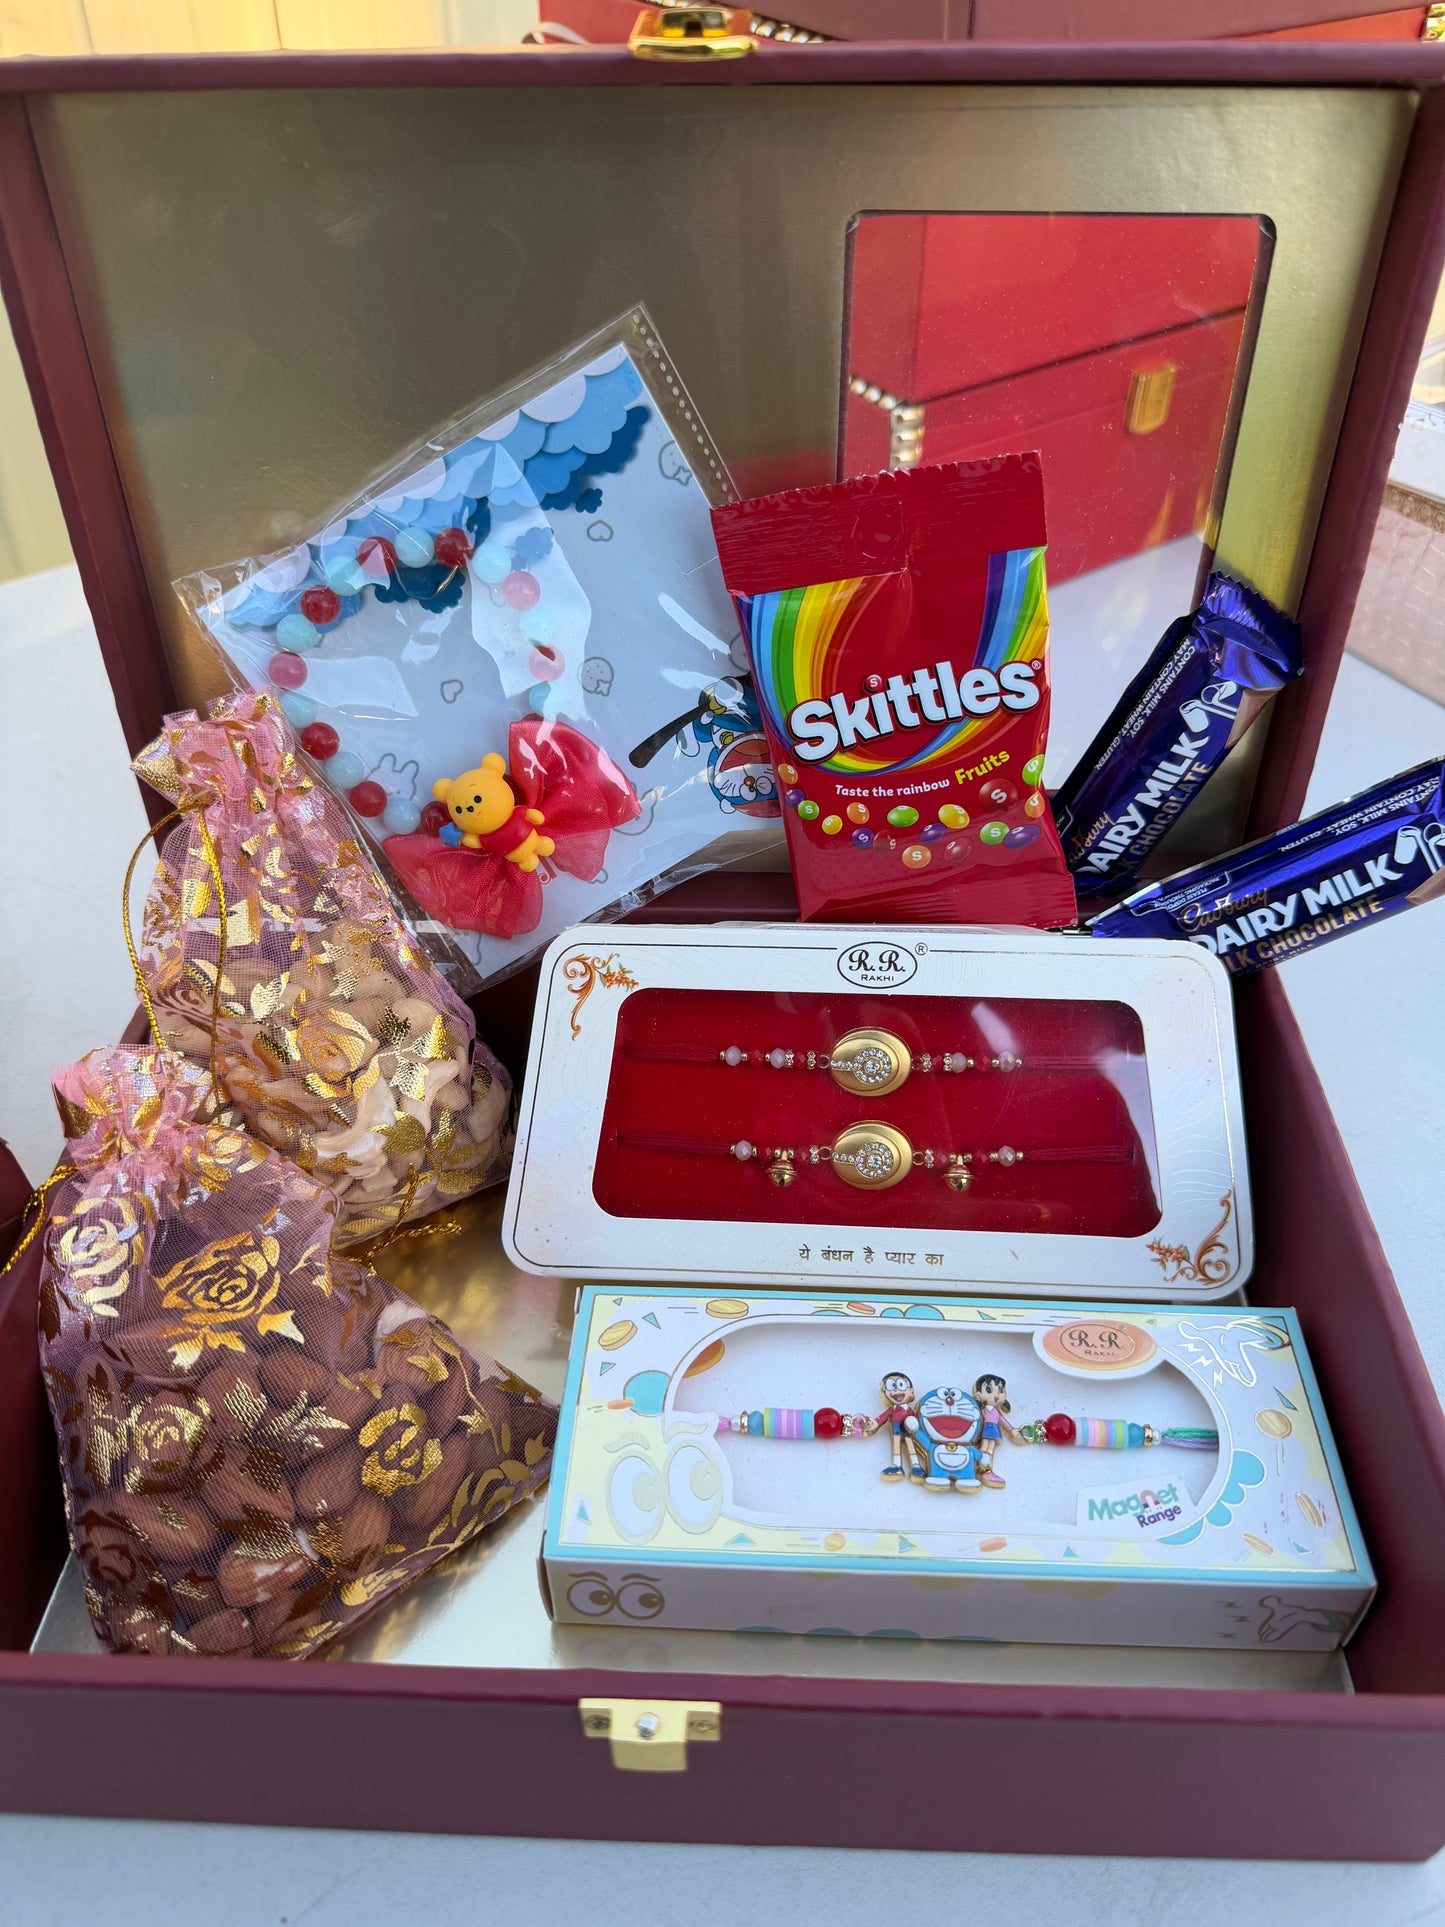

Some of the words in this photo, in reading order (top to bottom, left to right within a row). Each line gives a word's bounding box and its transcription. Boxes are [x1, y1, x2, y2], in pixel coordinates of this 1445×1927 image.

[1142, 661, 1174, 704] CONTAIN
[1160, 645, 1195, 694] CONTAINS
[790, 661, 1040, 761] Skittles
[835, 784, 869, 797] Taste
[872, 785, 894, 797] the
[897, 778, 950, 796] rainbow
[954, 750, 1011, 785] Fruits
[1134, 732, 1209, 808] MILK
[1129, 761, 1213, 857] CHOCOLATE
[1301, 853, 1404, 917] MILK
[1224, 947, 1255, 974] LK
[1256, 894, 1385, 961] CHOCOLATE
[799, 1243, 811, 1260] ये
[821, 1245, 854, 1262] बंधन
[862, 1246, 874, 1264] है
[885, 1251, 916, 1265] प्यार
[925, 1253, 944, 1266] का
[1087, 1483, 1179, 1521] Magnet
[1136, 1505, 1182, 1528] Range
